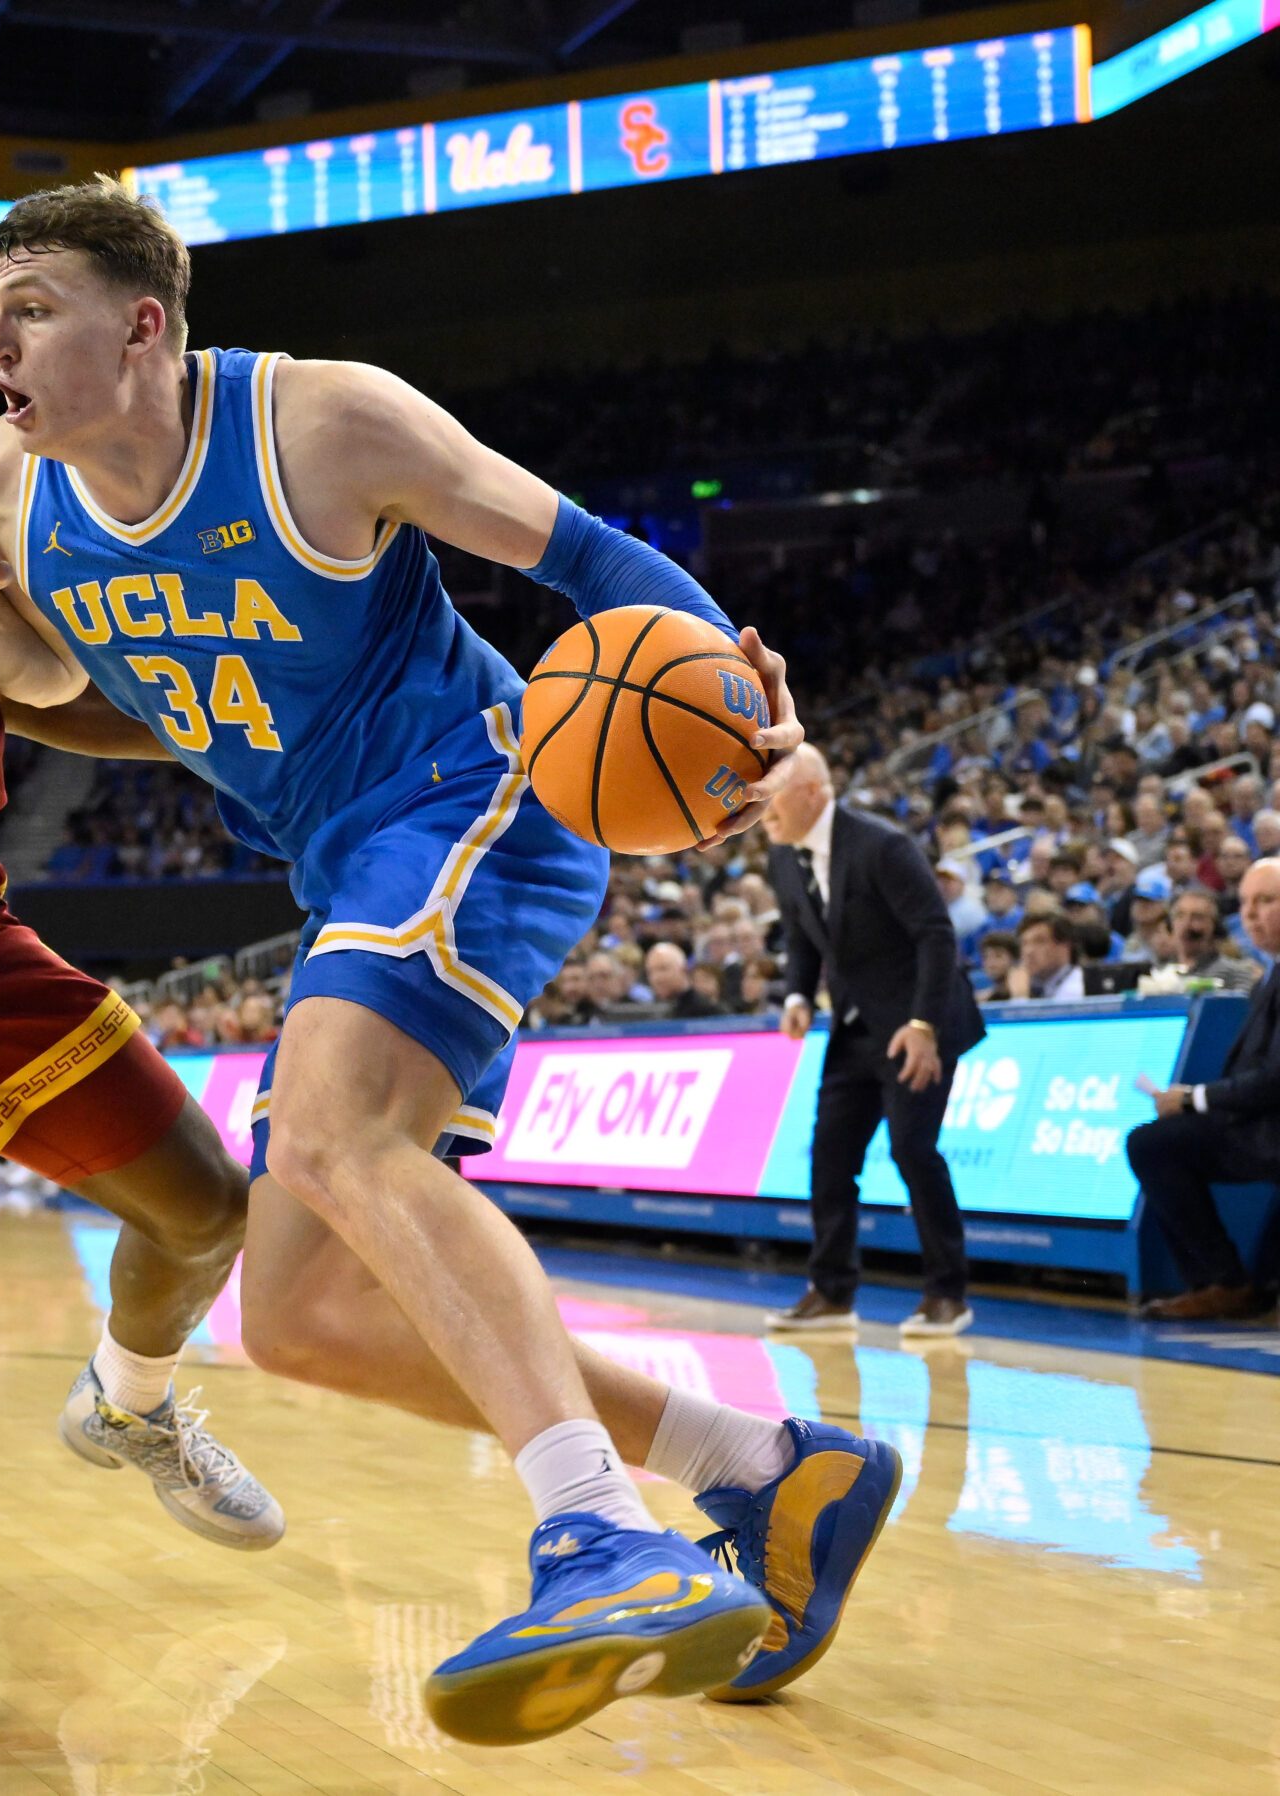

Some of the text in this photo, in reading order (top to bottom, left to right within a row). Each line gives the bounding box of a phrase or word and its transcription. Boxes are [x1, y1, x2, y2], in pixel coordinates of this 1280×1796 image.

[50, 573, 303, 645] UCLA
[124, 655, 283, 753] 34
[704, 764, 748, 818] UC
[528, 1069, 594, 1152] Fly
[1044, 1075, 1076, 1111] So
[1031, 1118, 1063, 1155] So
